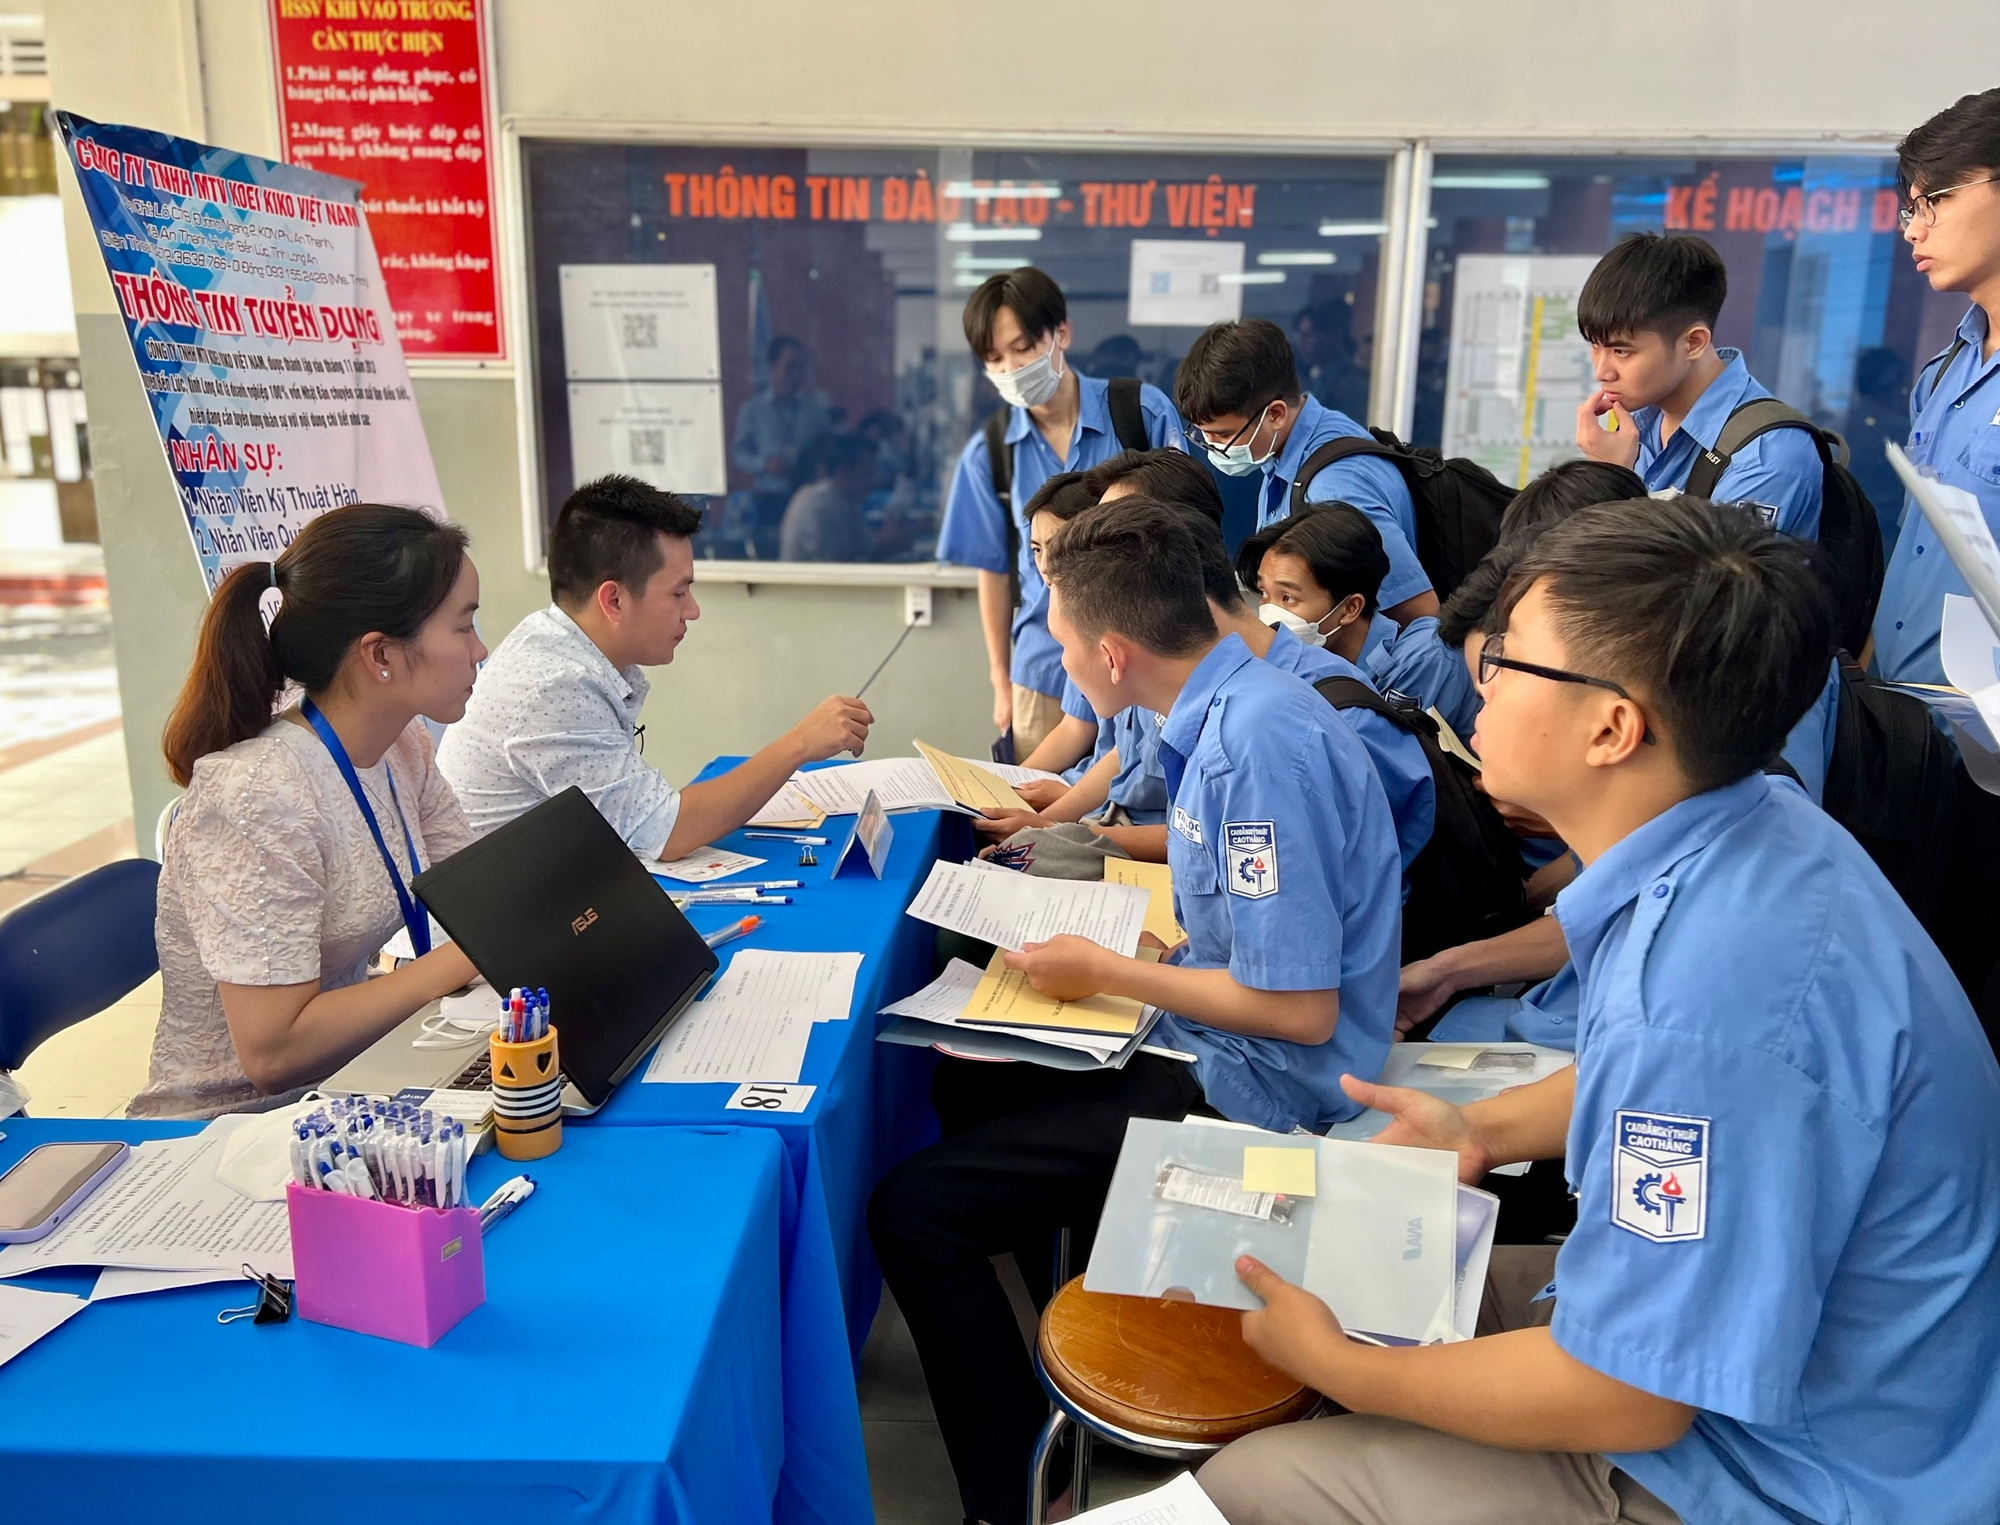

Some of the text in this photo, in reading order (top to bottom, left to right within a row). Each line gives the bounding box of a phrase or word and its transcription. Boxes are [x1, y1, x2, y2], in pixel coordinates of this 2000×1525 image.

[352, 29, 400, 56] THỰC
[402, 29, 444, 56] HIỆN
[76, 137, 360, 228] CÔNG TY TNHH MTV KOEI KIKO VIỆT NAM
[154, 202, 170, 219] Lô
[664, 165, 796, 219] THÔNG
[805, 175, 871, 221] TIN
[882, 168, 961, 223] ĐÀO
[1080, 179, 1157, 228] THƯ
[1166, 174, 1255, 237] VIỆN
[1665, 171, 1861, 240] KẾ HOẠCH
[160, 226, 177, 242] An
[307, 253, 319, 265] An
[113, 268, 383, 354] THÔNG TIN TUYỂN DỤNG
[146, 338, 168, 360] CÔNG
[172, 436, 283, 477] NHÂN SỰ:
[198, 487, 235, 515] Nhân
[234, 487, 267, 513] Viên
[266, 487, 287, 518] Kỹ
[287, 485, 331, 515] Thuật
[197, 529, 212, 555] 2.
[210, 527, 246, 554] Nhân
[245, 525, 278, 551] Viên
[571, 907, 599, 936] ASUS
[740, 1084, 788, 1109] 18
